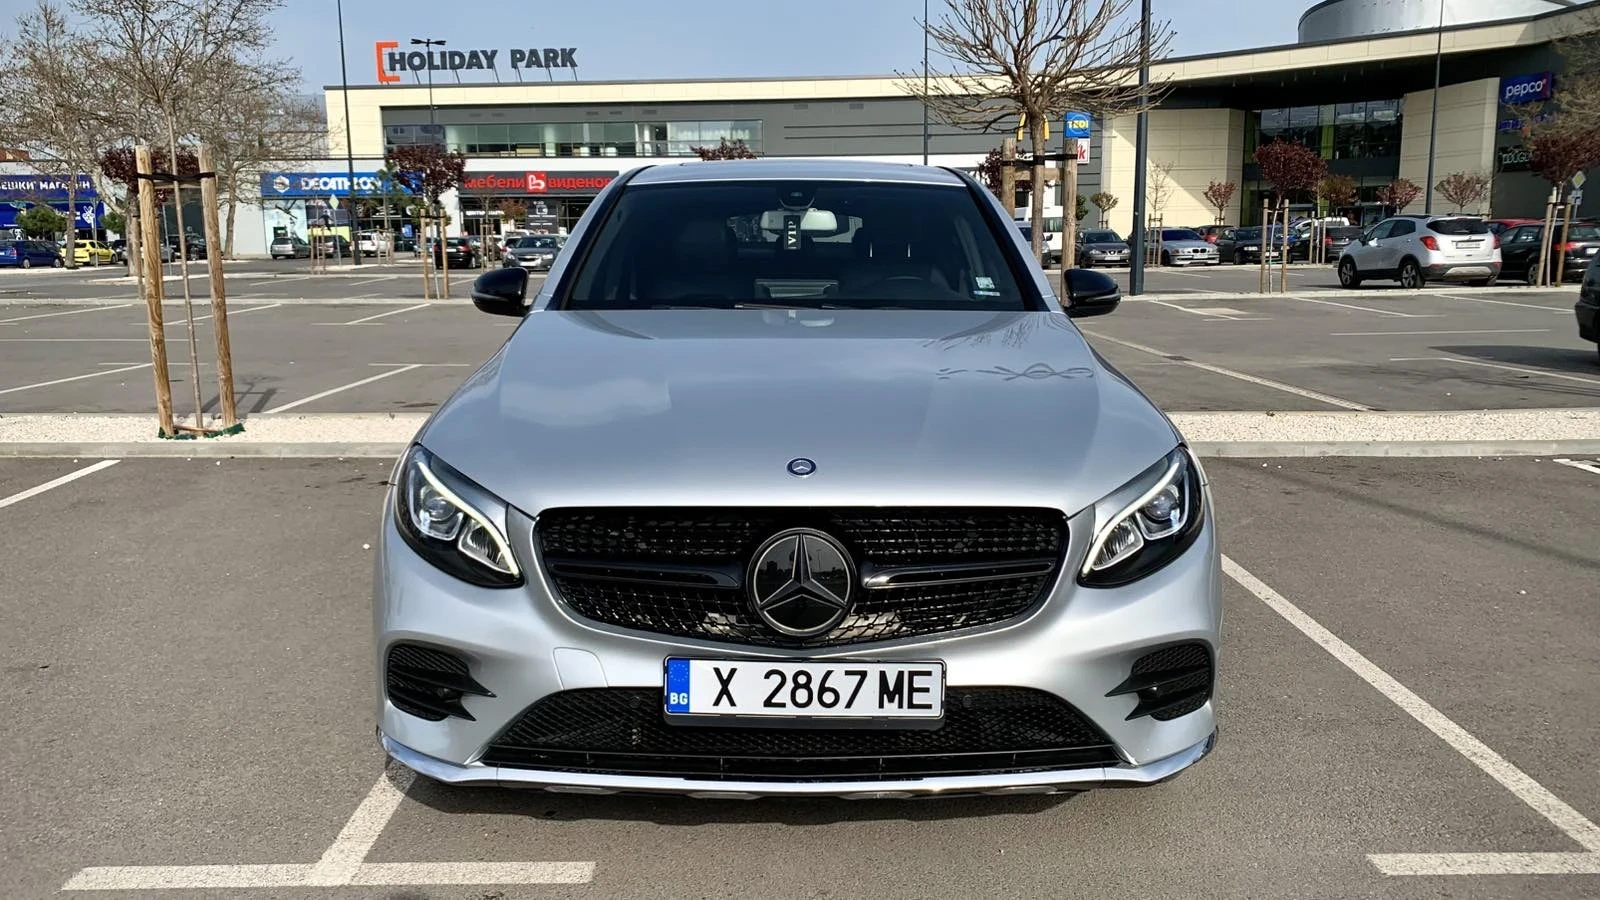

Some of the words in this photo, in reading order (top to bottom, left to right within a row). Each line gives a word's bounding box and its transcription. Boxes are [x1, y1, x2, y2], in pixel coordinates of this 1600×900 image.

[388, 49, 498, 72] HOLIDAY
[510, 48, 578, 69] PARK
[1505, 79, 1543, 99] pepco
[0, 181, 35, 191] ЕШКИ
[464, 174, 525, 189] мебели
[787, 220, 797, 245] VIP
[670, 692, 688, 705] BG
[712, 667, 738, 707] X
[763, 669, 868, 709] 2867
[878, 670, 933, 710] ME
